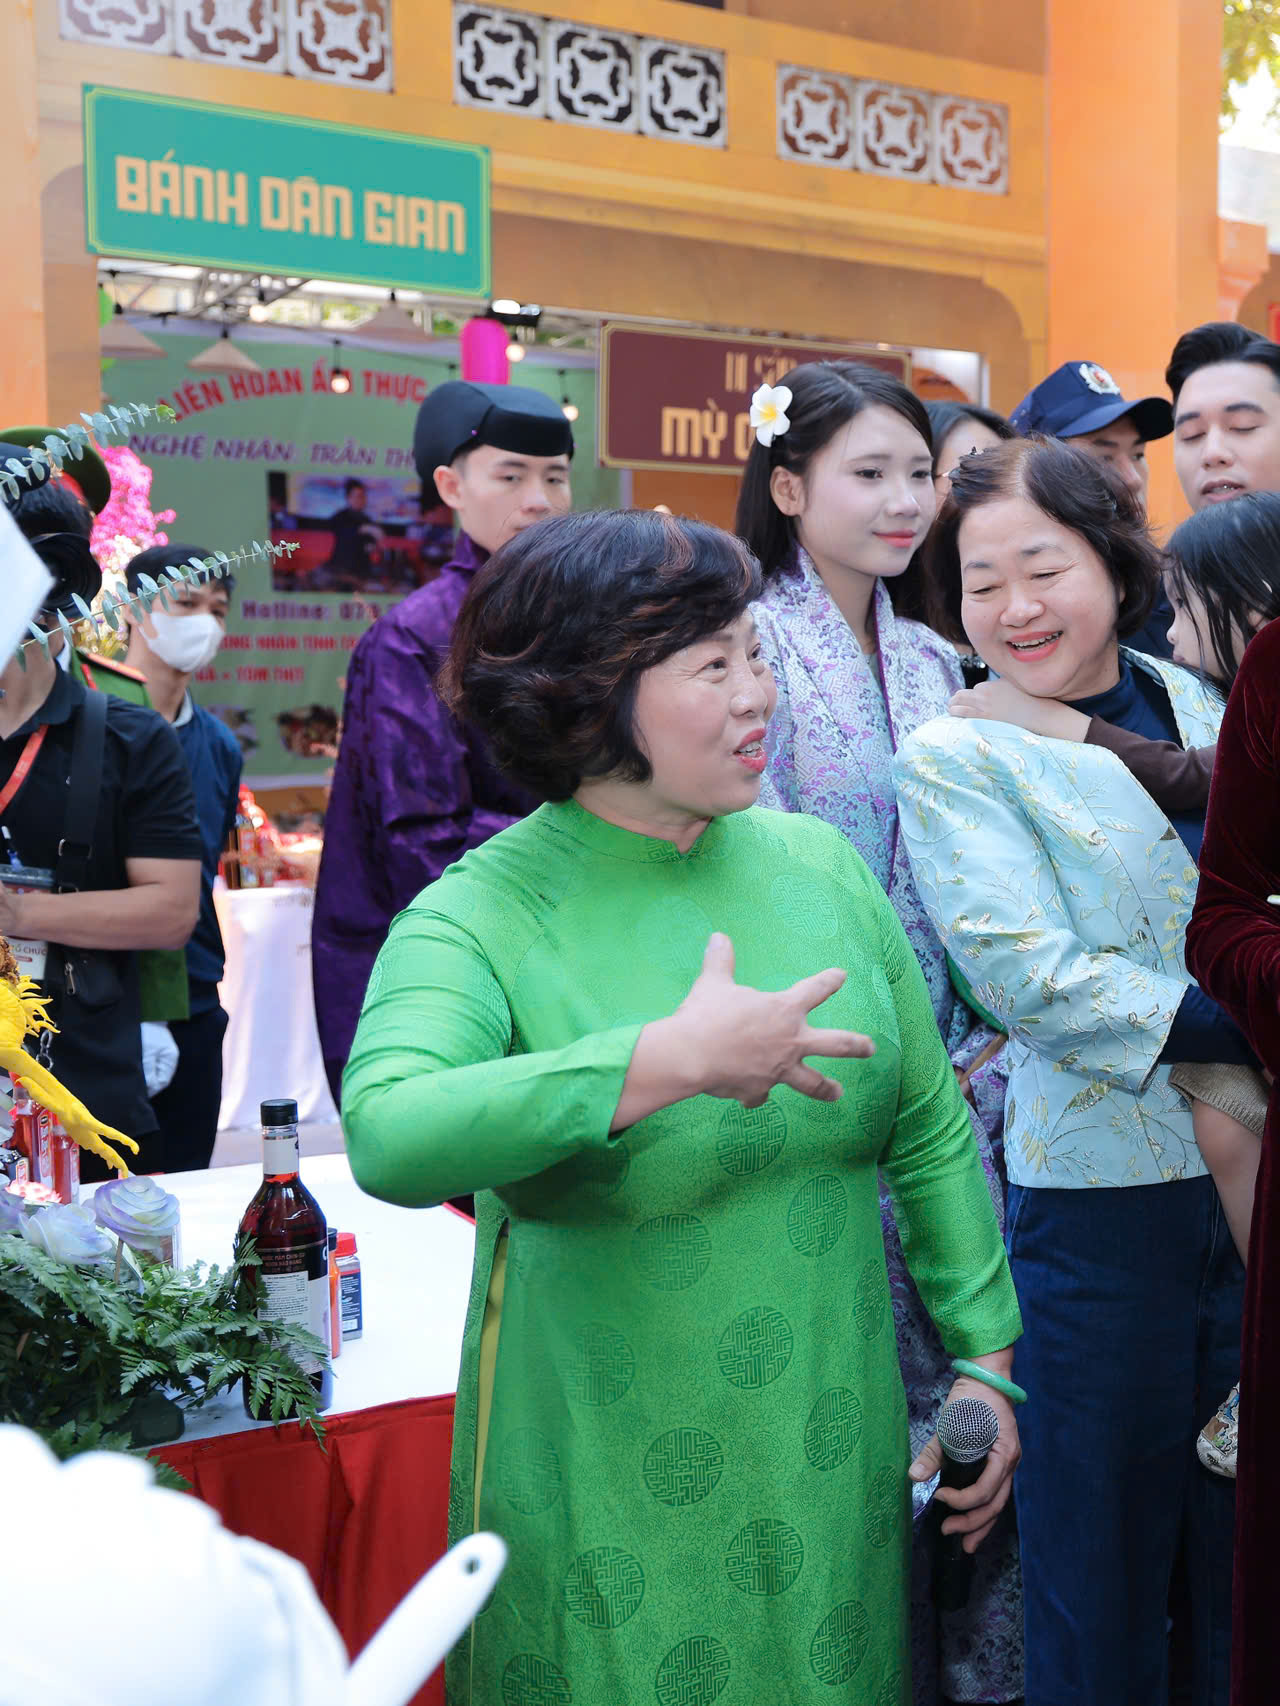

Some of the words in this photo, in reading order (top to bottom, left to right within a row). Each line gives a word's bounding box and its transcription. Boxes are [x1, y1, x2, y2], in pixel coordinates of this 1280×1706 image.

[115, 150, 248, 226] BÁNH
[259, 176, 354, 240] DÂN
[363, 190, 466, 255] GIAN
[229, 366, 303, 400] HOAN
[127, 433, 206, 462] NGHỆ
